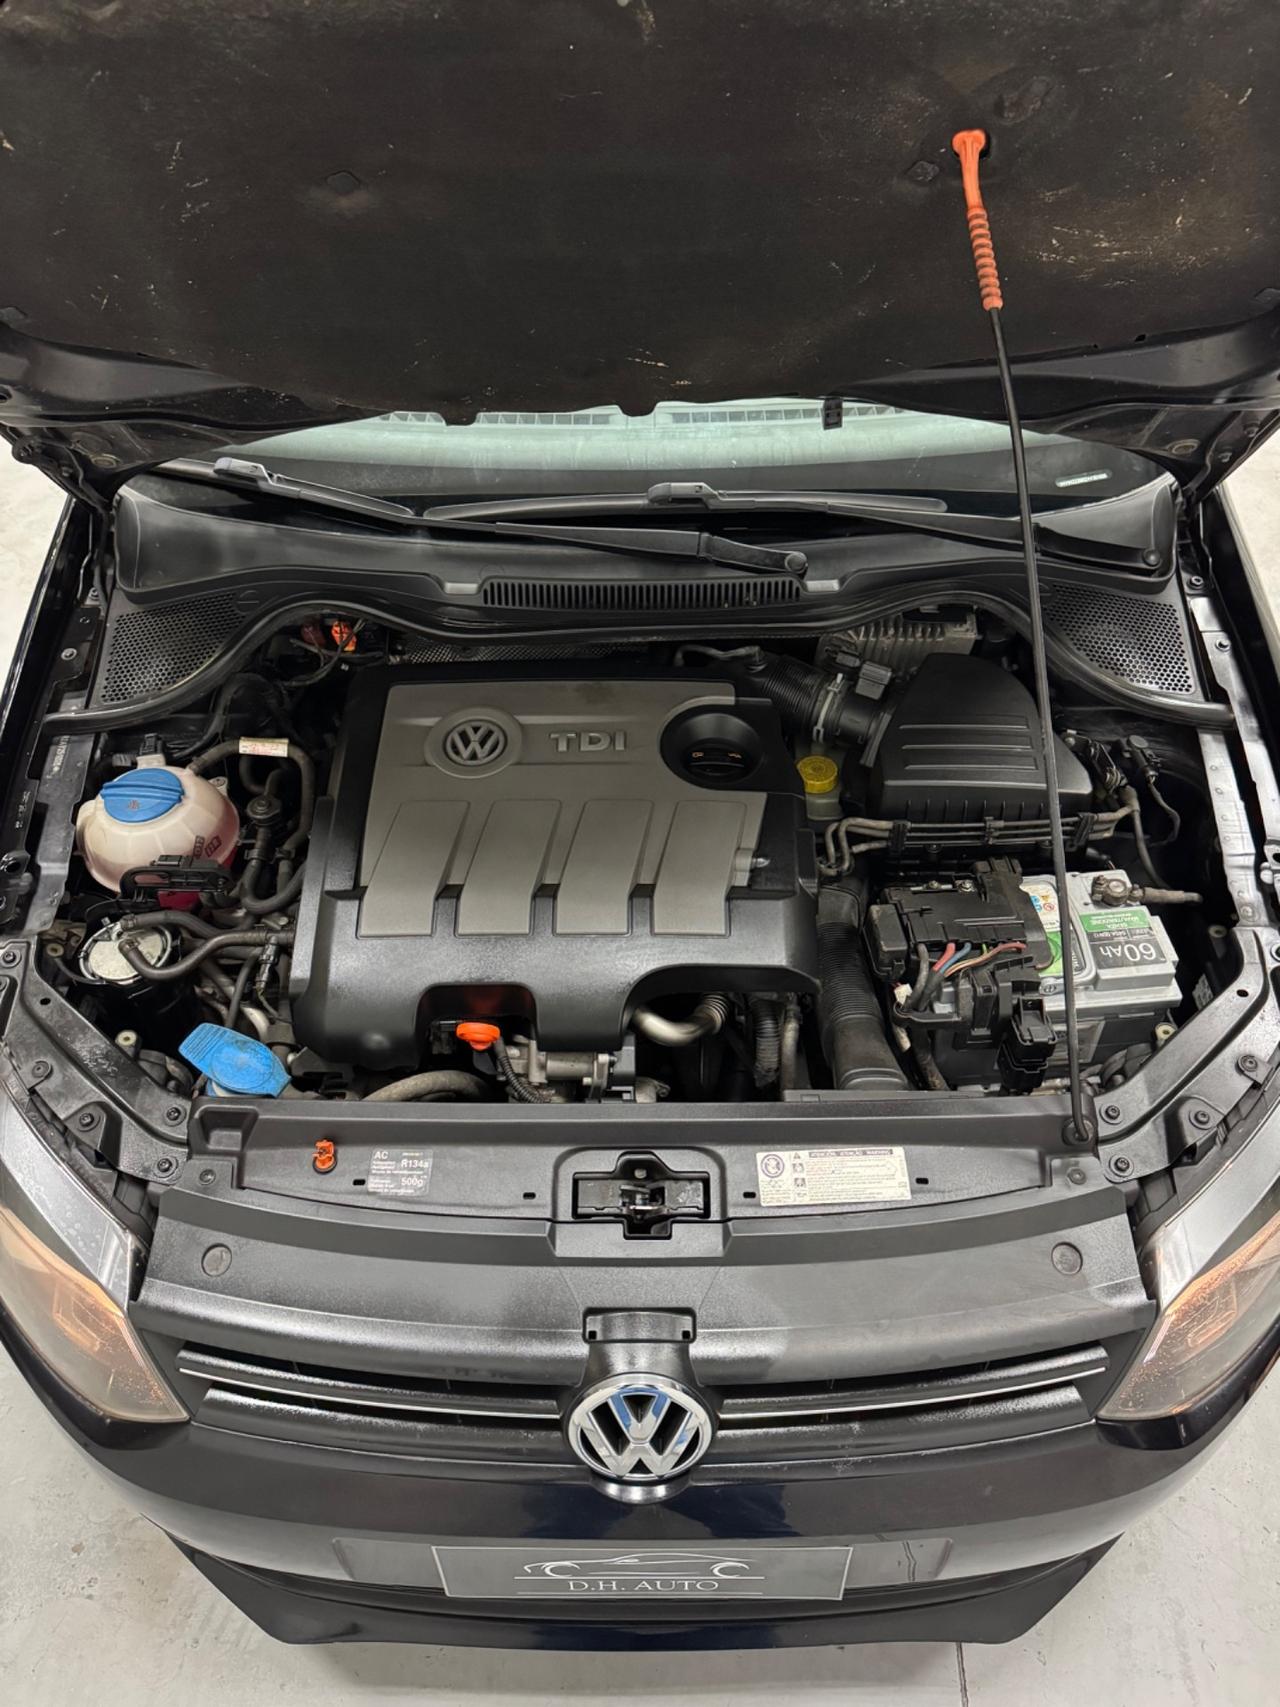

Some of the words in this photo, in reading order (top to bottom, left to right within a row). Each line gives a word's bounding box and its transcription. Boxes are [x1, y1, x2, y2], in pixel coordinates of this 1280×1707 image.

[550, 731, 628, 752] TDI
[1099, 942, 1156, 962] 60Ah
[374, 1151, 389, 1160] AC
[401, 1158, 429, 1169] R134a
[401, 1176, 424, 1188] 500g
[568, 1580, 626, 1591] D.H.
[633, 1580, 719, 1591] AUTO
